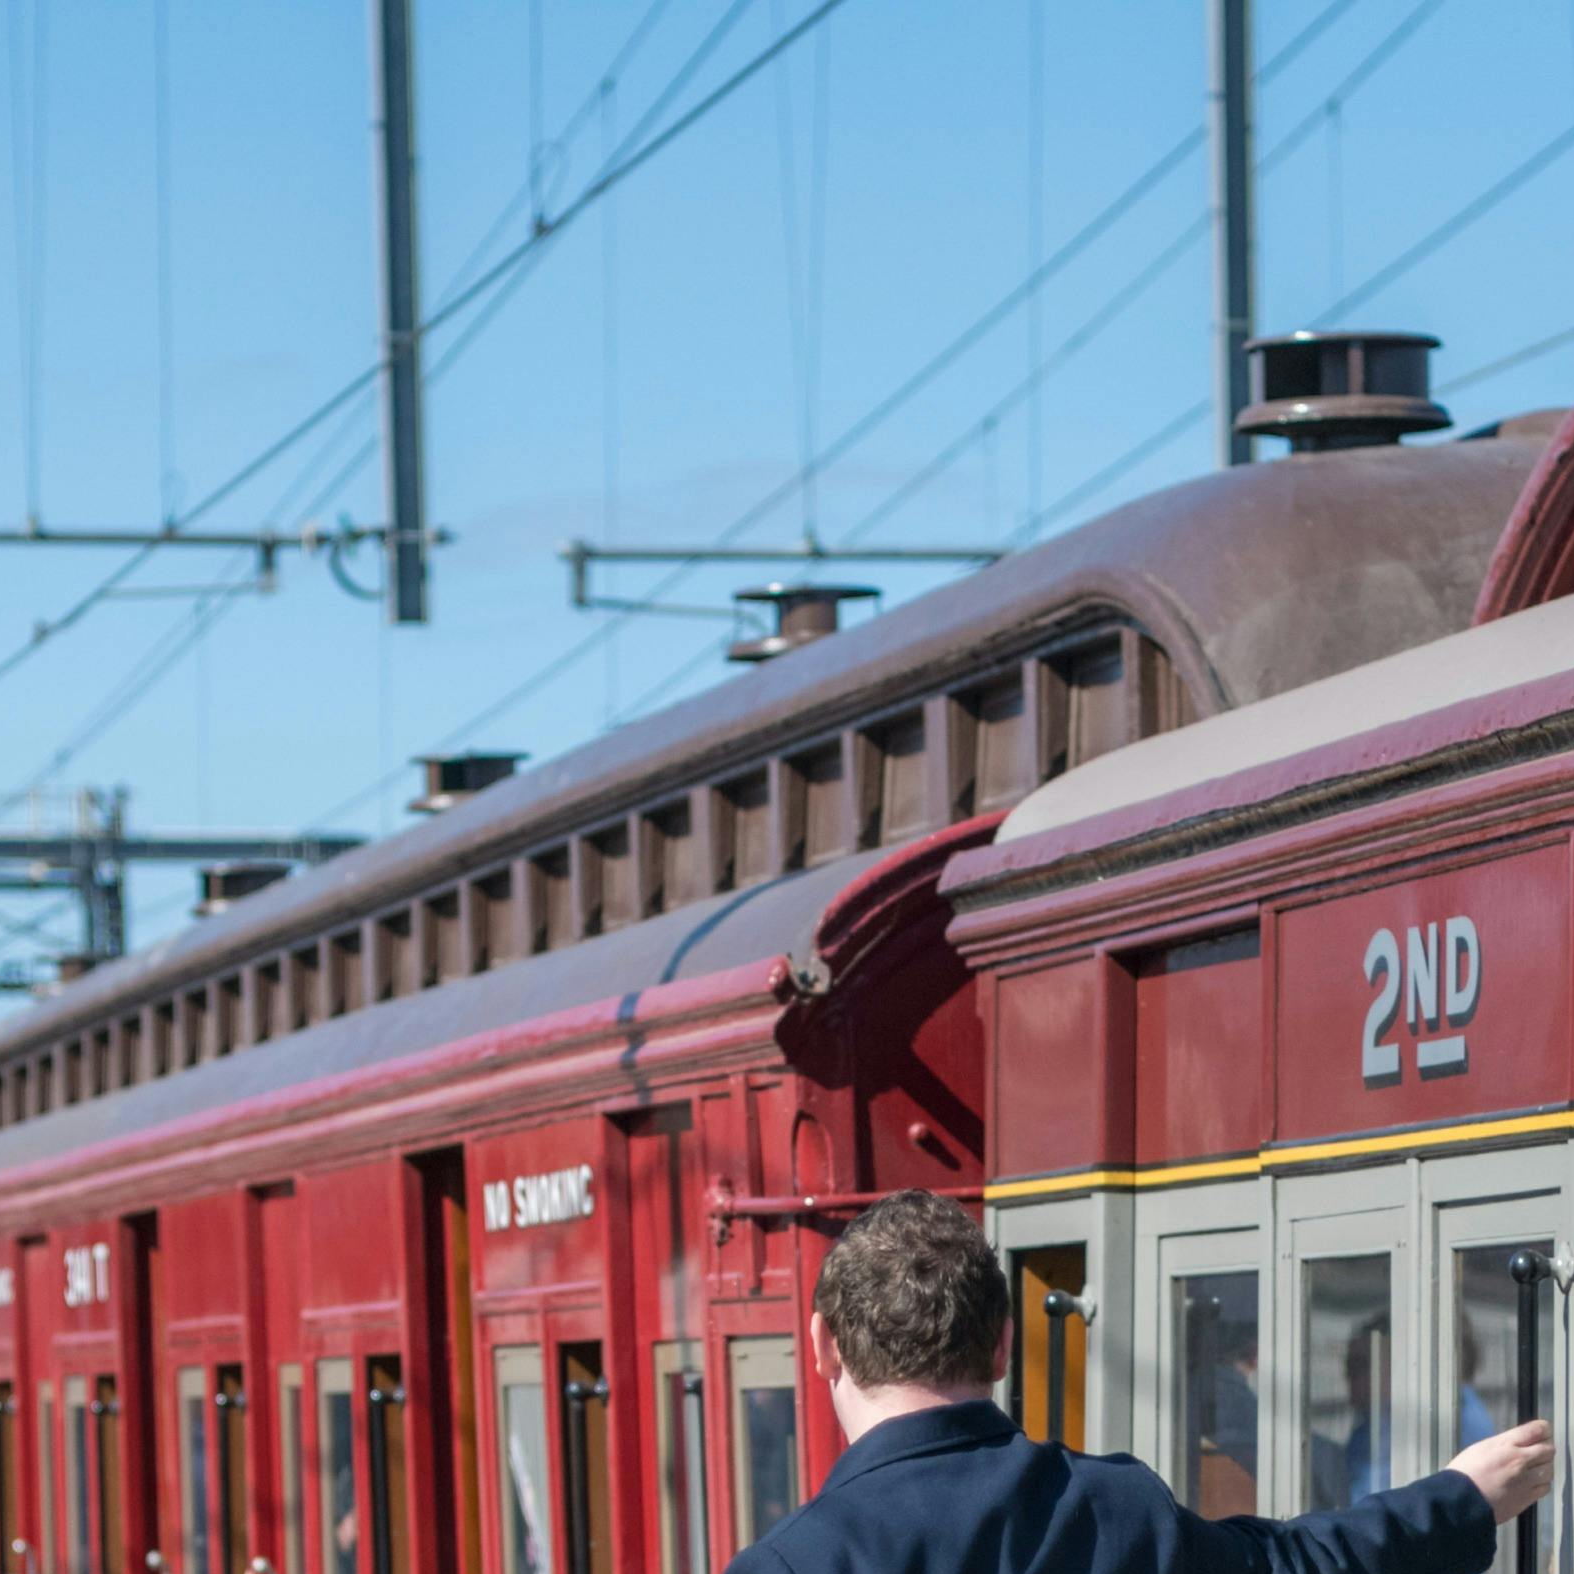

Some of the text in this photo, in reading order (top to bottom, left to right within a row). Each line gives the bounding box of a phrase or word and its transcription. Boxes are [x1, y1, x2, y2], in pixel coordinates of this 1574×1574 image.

[1362, 915, 1481, 1090] 2ND
[483, 1163, 594, 1232] NO SMOKING
